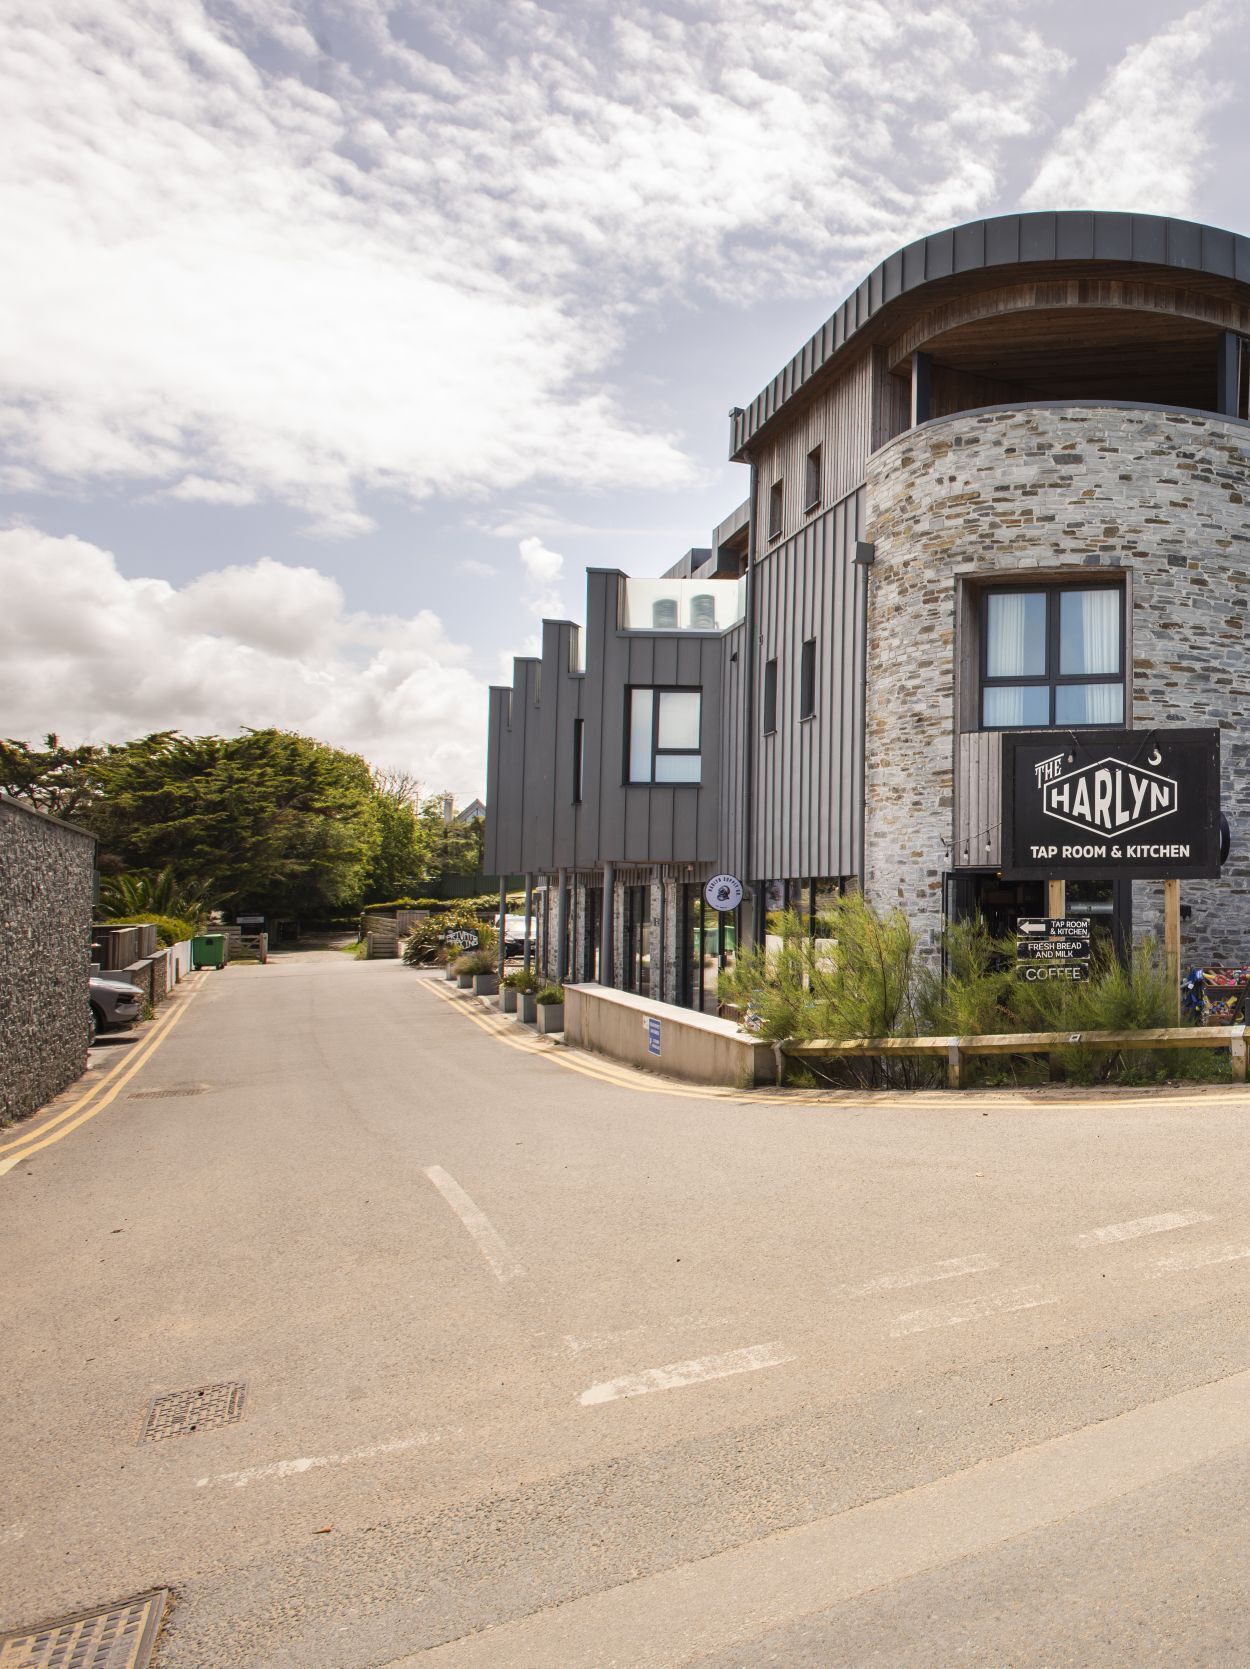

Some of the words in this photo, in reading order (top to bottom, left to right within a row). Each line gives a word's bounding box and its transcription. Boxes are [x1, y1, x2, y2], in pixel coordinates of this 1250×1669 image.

[1034, 756, 1062, 789] THE
[1051, 767, 1169, 829] HARLYN
[1030, 845, 1058, 859] TAP
[1062, 845, 1106, 858] ROOM
[1110, 845, 1122, 858] &
[1126, 844, 1190, 858] KITCHEN
[1051, 920, 1065, 928] TAP
[1028, 943, 1055, 951] FRESH
[1056, 942, 1082, 950] BREAD
[1055, 950, 1074, 958] MILK
[1026, 967, 1081, 980] COFFEE
